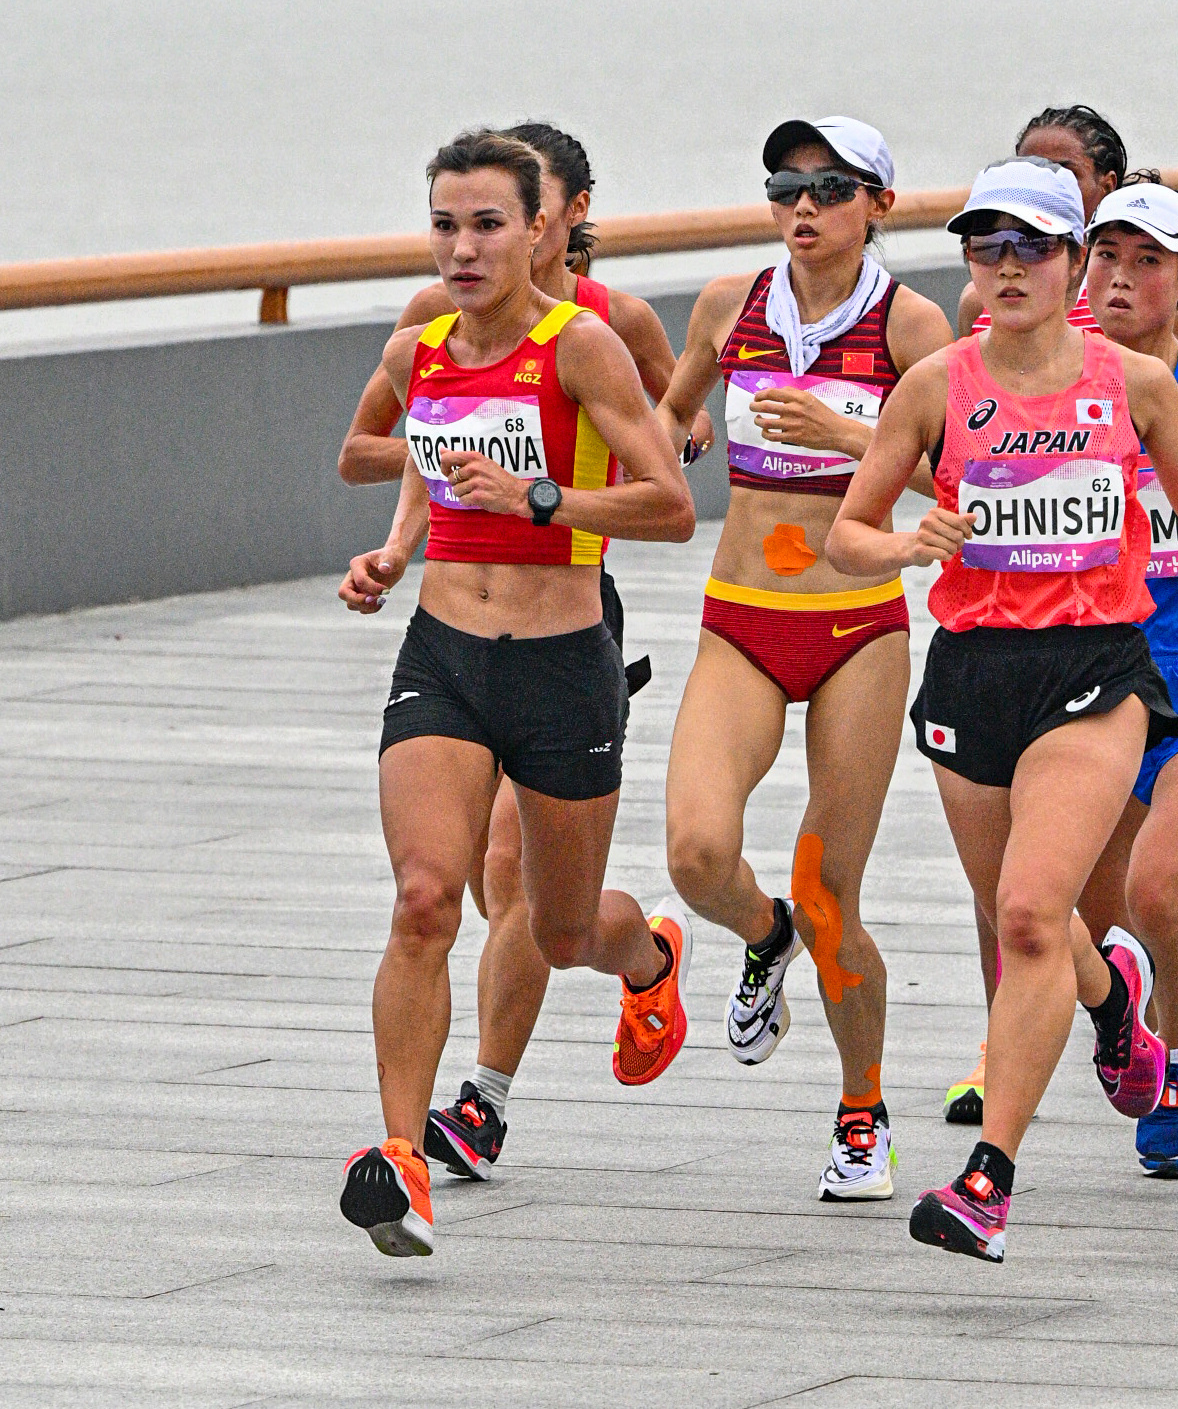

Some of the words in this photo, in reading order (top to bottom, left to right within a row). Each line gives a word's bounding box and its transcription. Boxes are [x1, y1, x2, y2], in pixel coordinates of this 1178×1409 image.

[513, 373, 541, 385] KGZ
[844, 402, 864, 415] 54
[505, 418, 525, 432] 68
[991, 431, 1091, 454] JAPAN
[762, 456, 812, 475] Alipay
[1092, 478, 1111, 492] 62
[966, 495, 1120, 536] OHNISHI
[1008, 549, 1062, 568] Alipay
